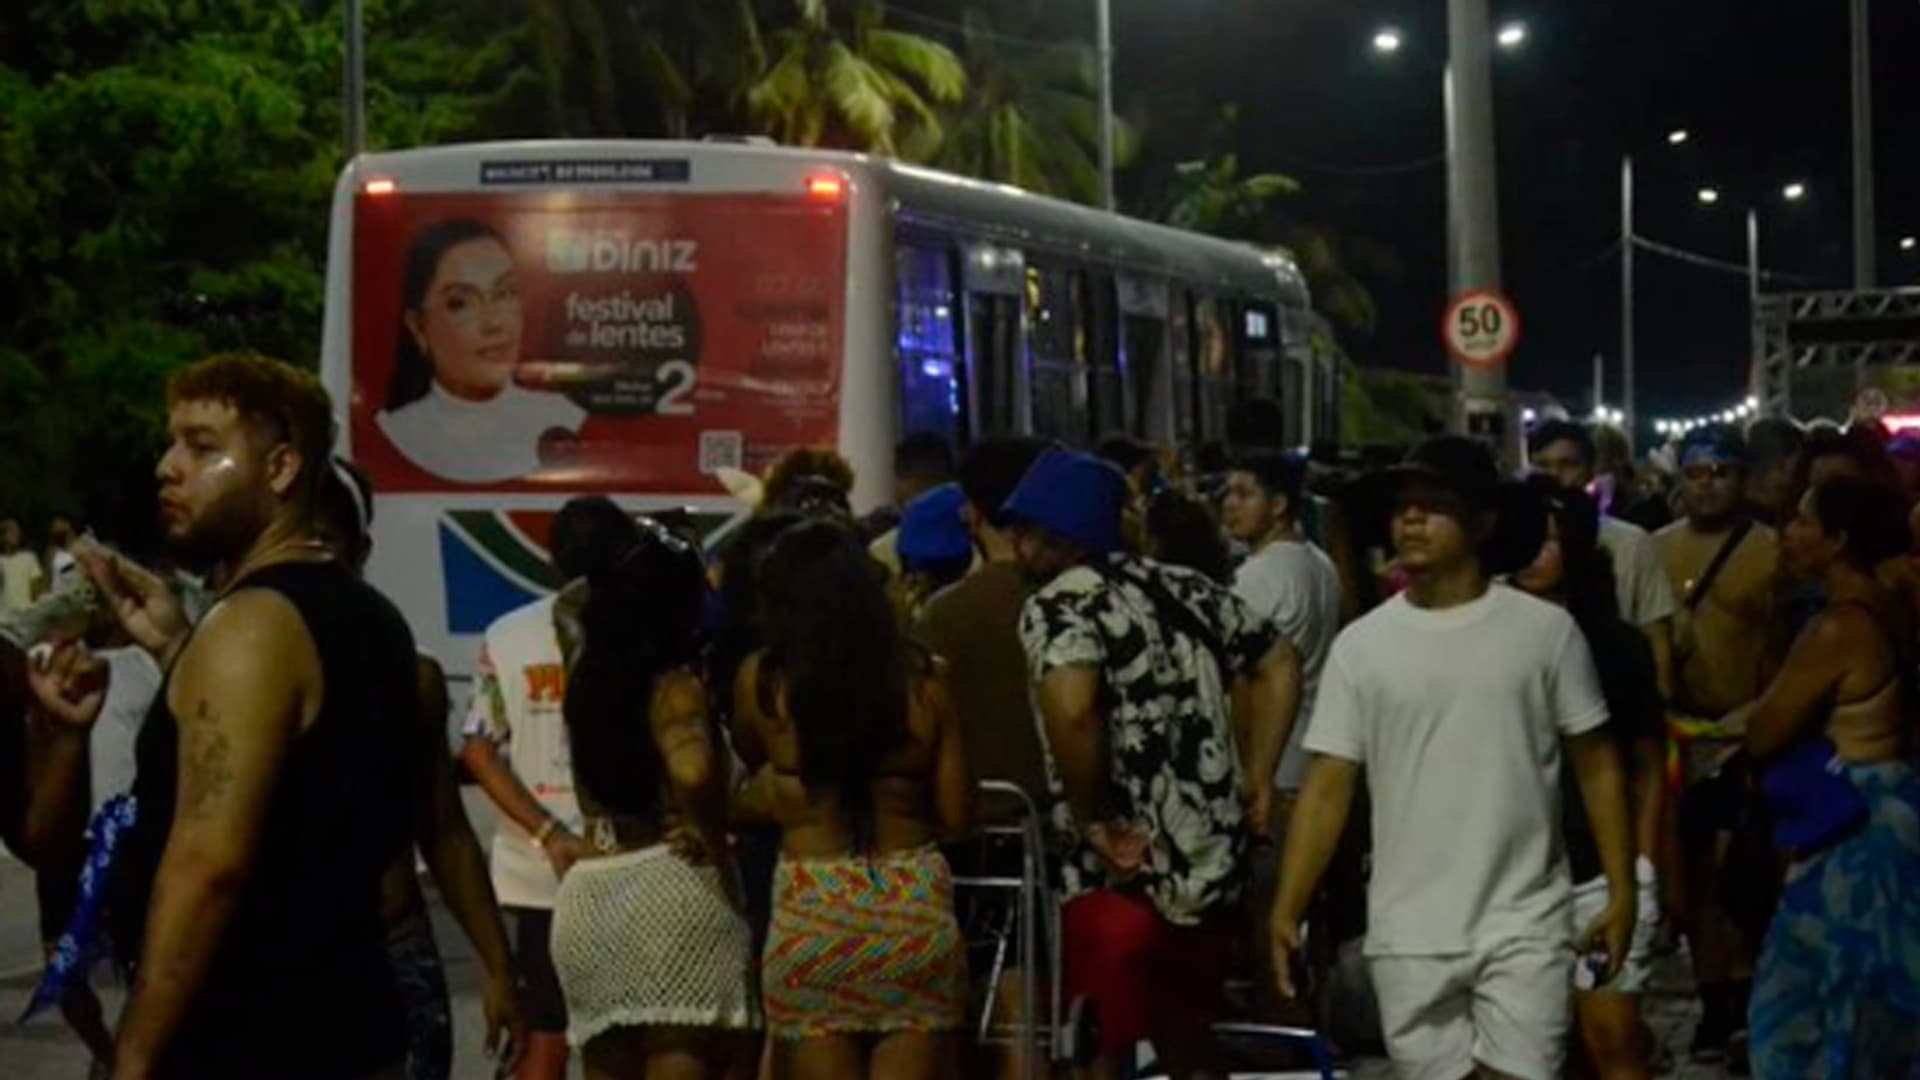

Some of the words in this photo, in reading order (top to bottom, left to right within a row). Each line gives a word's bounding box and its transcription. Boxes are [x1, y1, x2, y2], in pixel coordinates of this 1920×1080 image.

[566, 292, 674, 320] festival
[1459, 303, 1502, 337] 50
[590, 322, 685, 348] lentes
[656, 359, 697, 415] 2
